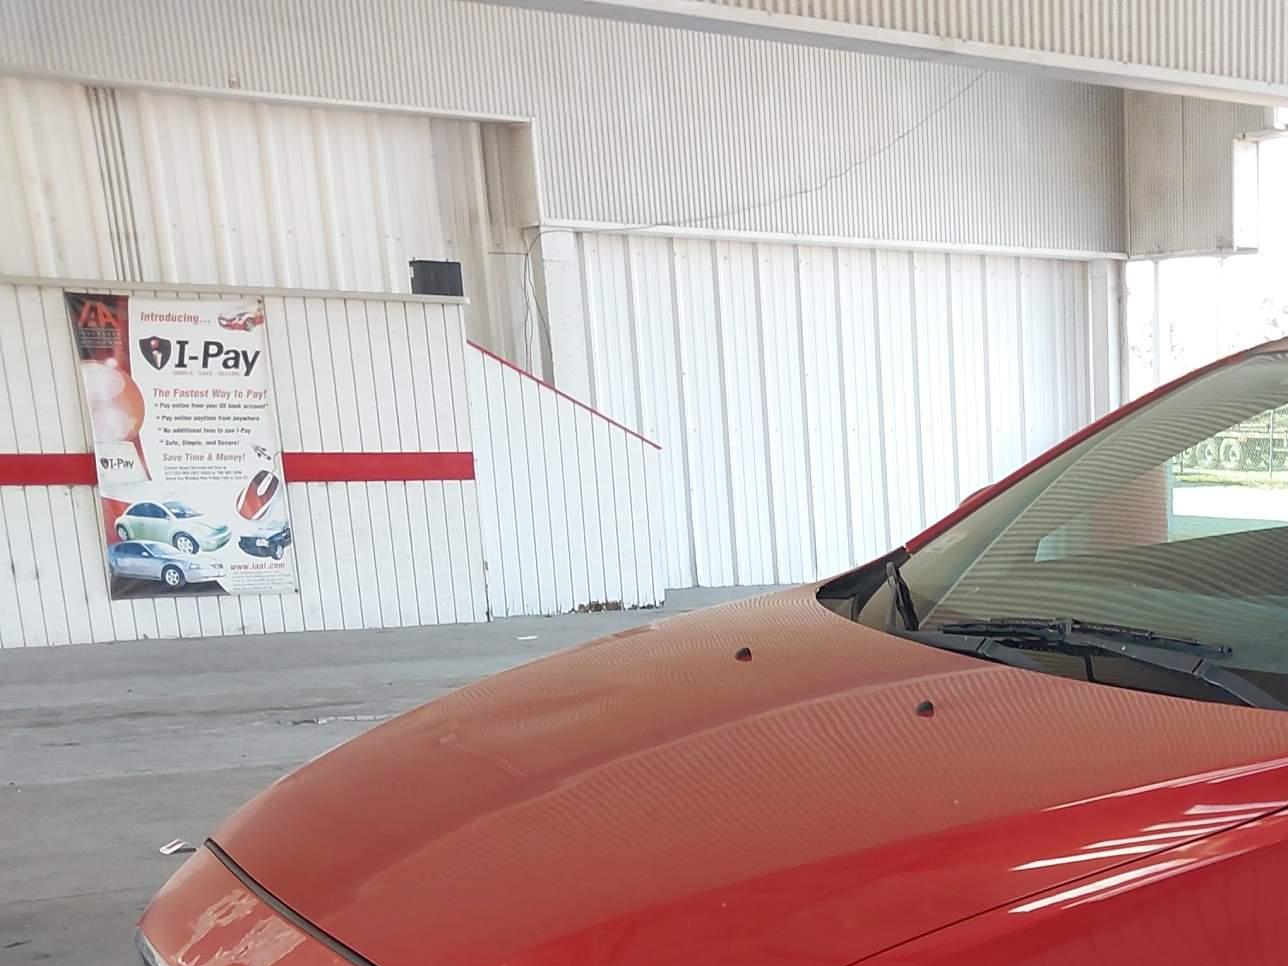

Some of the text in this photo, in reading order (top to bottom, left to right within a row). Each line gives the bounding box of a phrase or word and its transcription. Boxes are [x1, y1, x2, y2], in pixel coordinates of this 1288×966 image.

[174, 340, 261, 376] I-Pay
[153, 387, 267, 401] The Fastest Way to Pay!
[110, 458, 134, 469] I-Pay
[162, 453, 245, 463] Save Time & Money!
